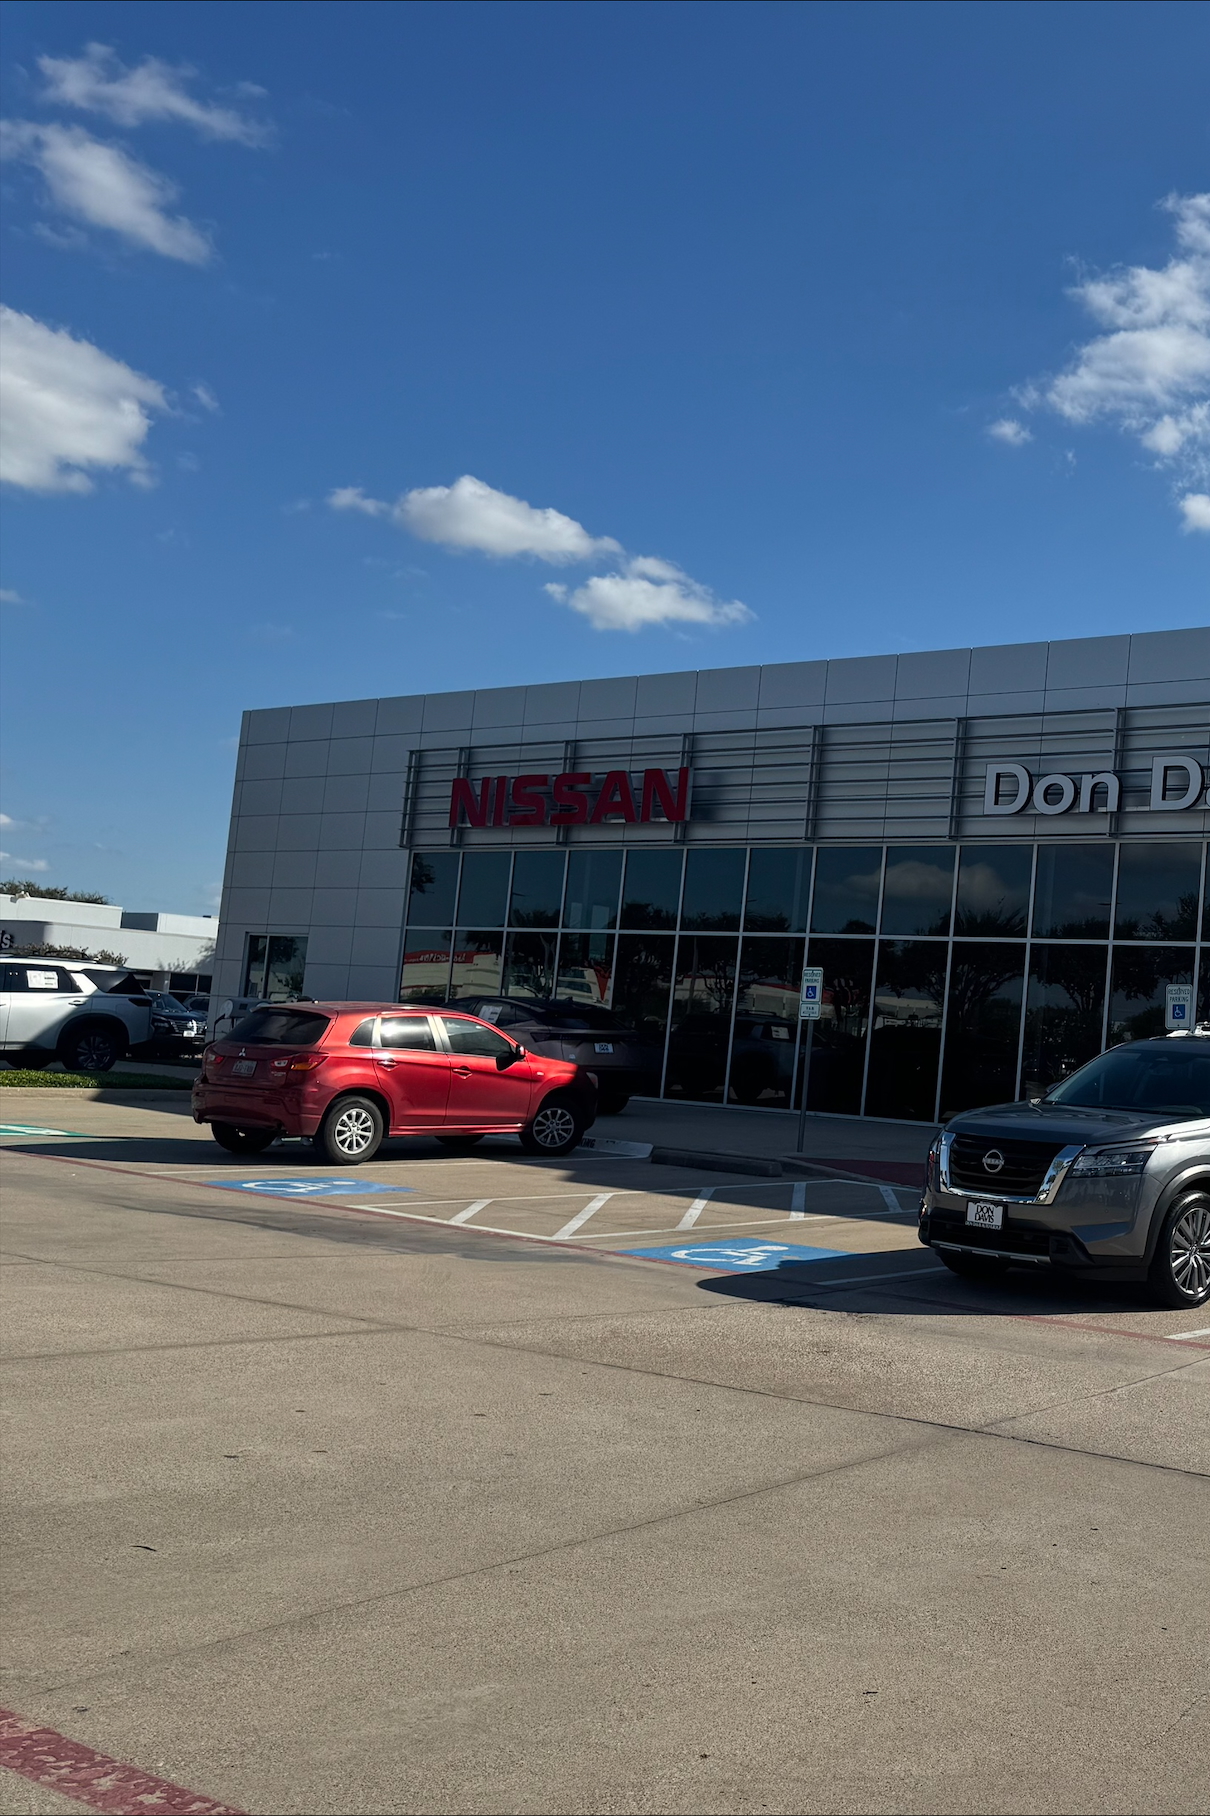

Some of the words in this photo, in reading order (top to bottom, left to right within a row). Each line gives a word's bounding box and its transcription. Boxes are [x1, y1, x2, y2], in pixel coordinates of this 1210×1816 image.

[449, 767, 691, 827] NISSAN
[984, 762, 1120, 815] Don
[975, 1212, 995, 1223] DAVIS
[977, 1205, 994, 1216] DON
